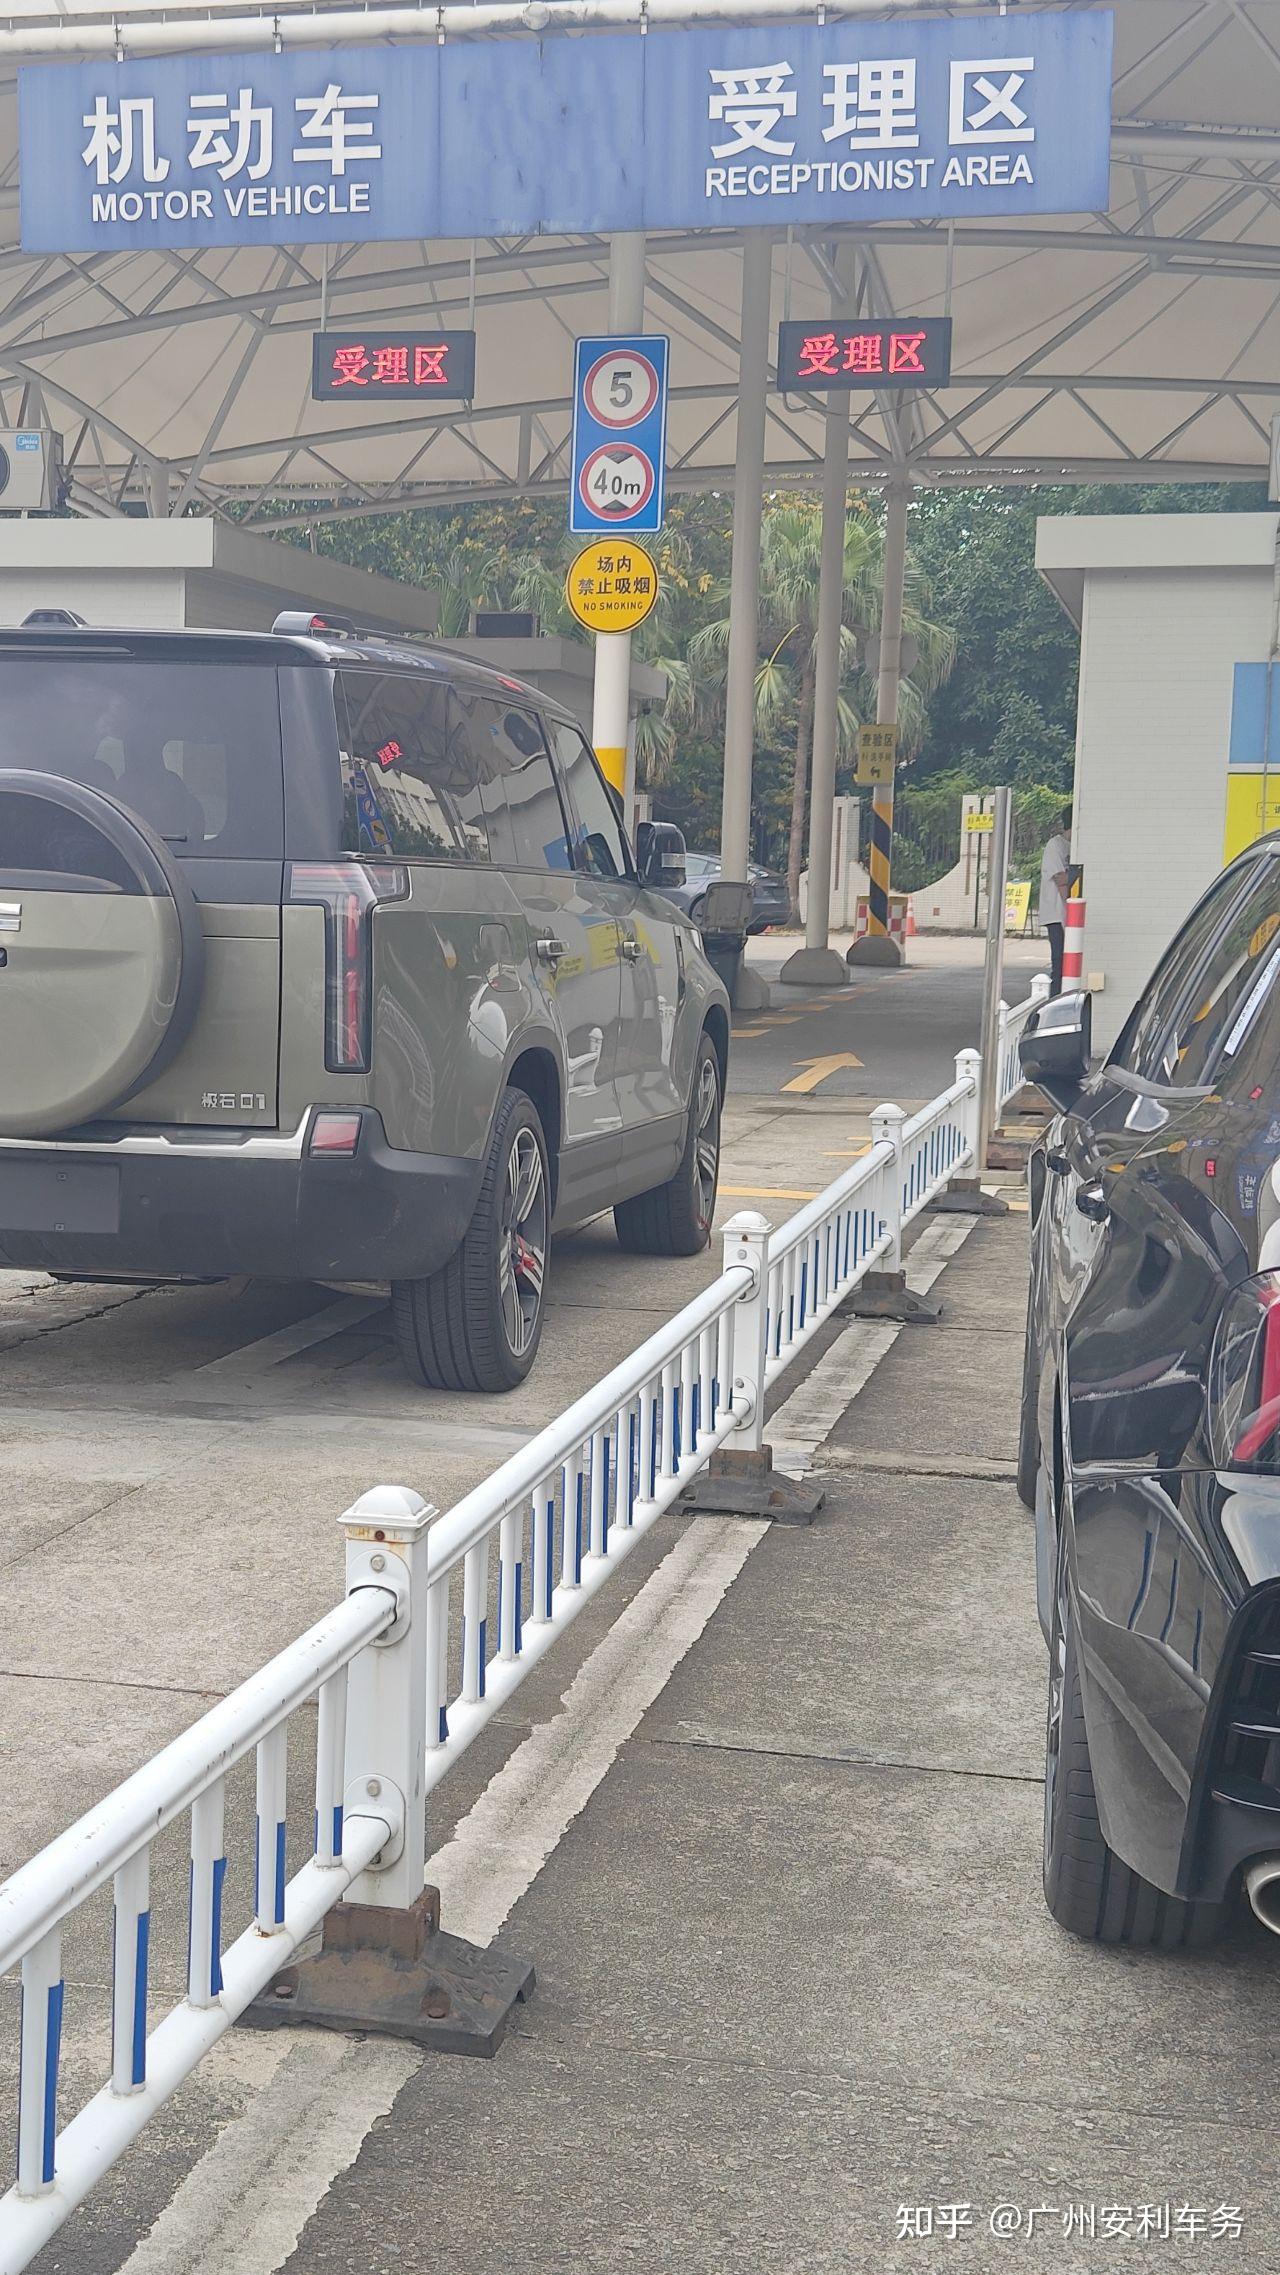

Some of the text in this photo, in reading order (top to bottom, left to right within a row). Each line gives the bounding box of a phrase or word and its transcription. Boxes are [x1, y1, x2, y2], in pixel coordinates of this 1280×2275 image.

[708, 57, 1036, 160] 受理区
[82, 84, 382, 185] 机动车
[705, 154, 1034, 198] RECEPTIONIST AREA
[91, 183, 371, 222] MOTOR VEHICLE
[331, 343, 450, 387] 受理区
[797, 331, 927, 377] 受理区
[608, 371, 632, 408] 5
[597, 555, 631, 573] 场内
[578, 576, 650, 595] 禁止吸烟
[583, 601, 643, 611] NO SMOKING
